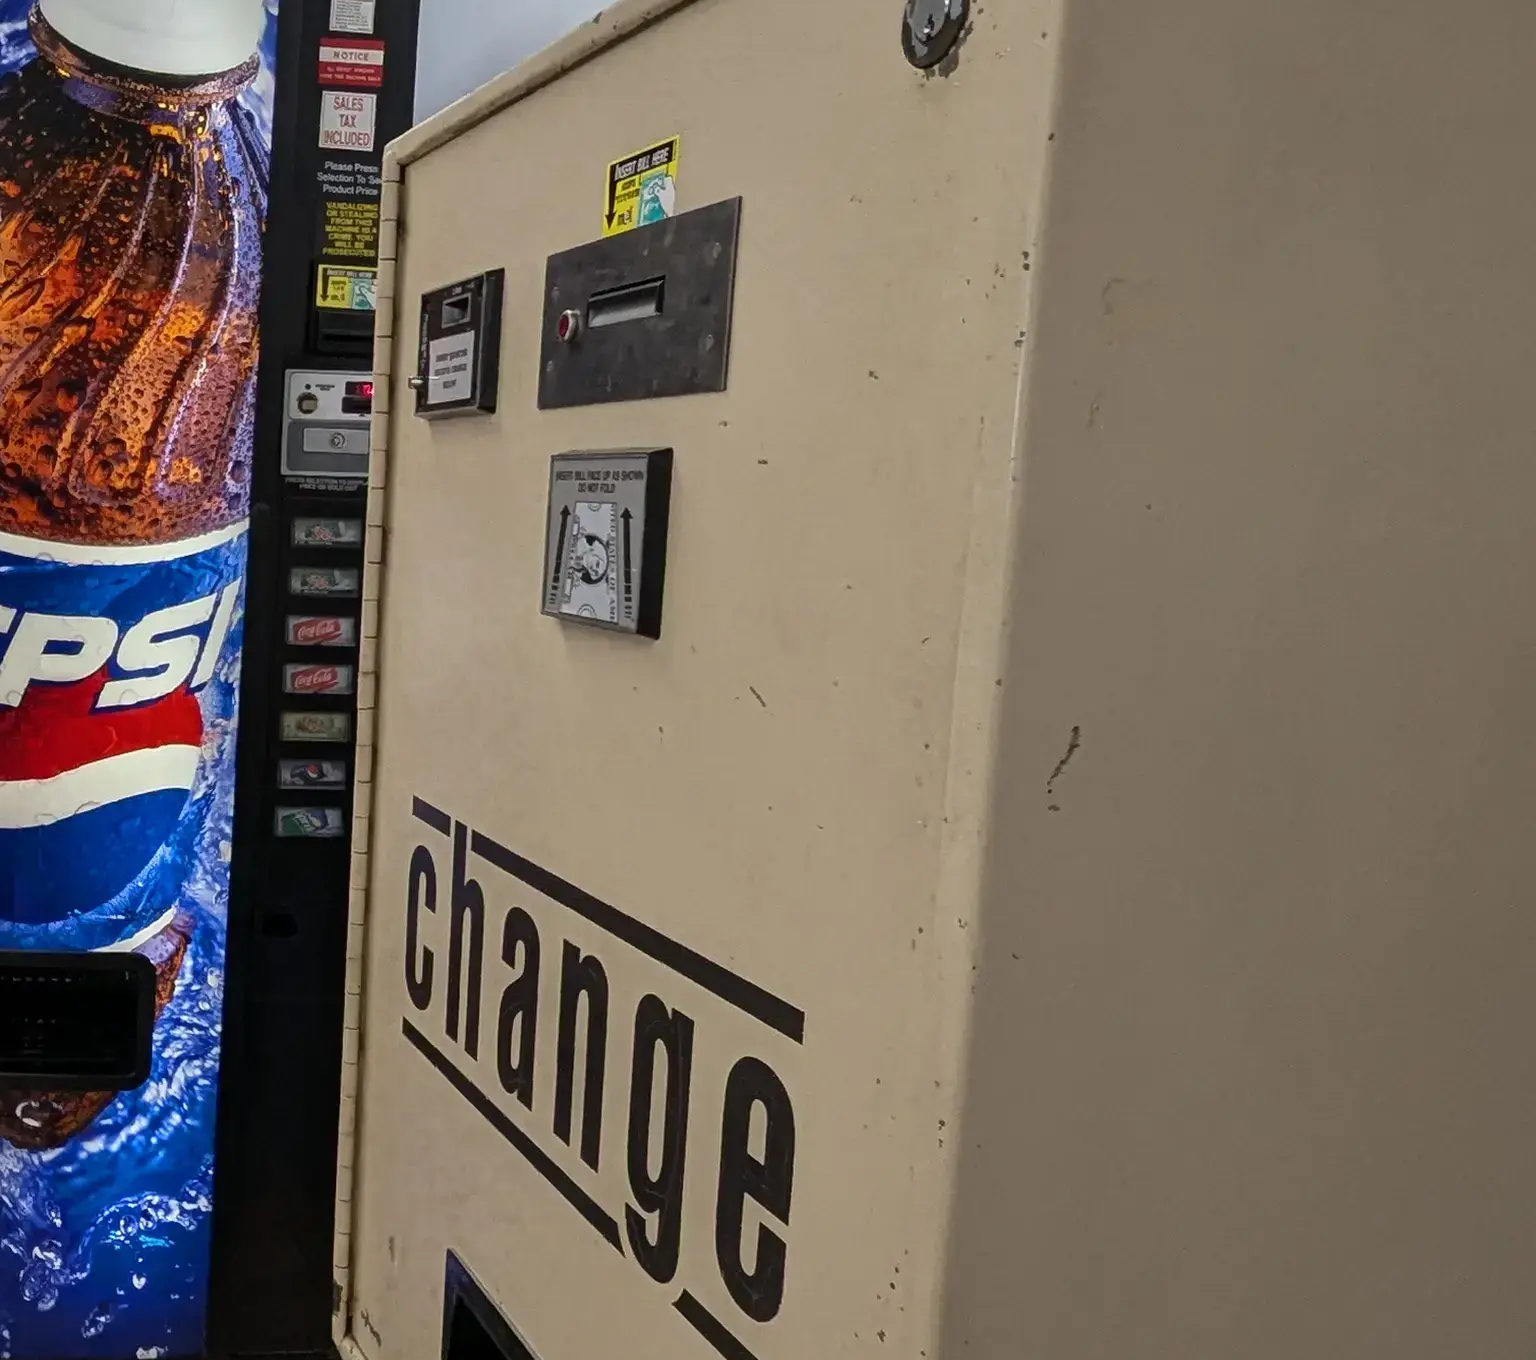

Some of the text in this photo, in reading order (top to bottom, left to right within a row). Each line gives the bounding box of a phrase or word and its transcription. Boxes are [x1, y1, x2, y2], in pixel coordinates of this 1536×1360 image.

[333, 51, 369, 61] NOTICE
[333, 96, 363, 111] SALES
[339, 114, 356, 128] TAX
[324, 130, 370, 146] INCLUDED
[324, 161, 353, 171] Please
[614, 160, 637, 181] INSERT
[637, 154, 651, 172] BILL
[317, 172, 354, 183] Selection
[356, 174, 366, 184] To
[323, 184, 378, 196] Product Price
[405, 820, 796, 1323] change
